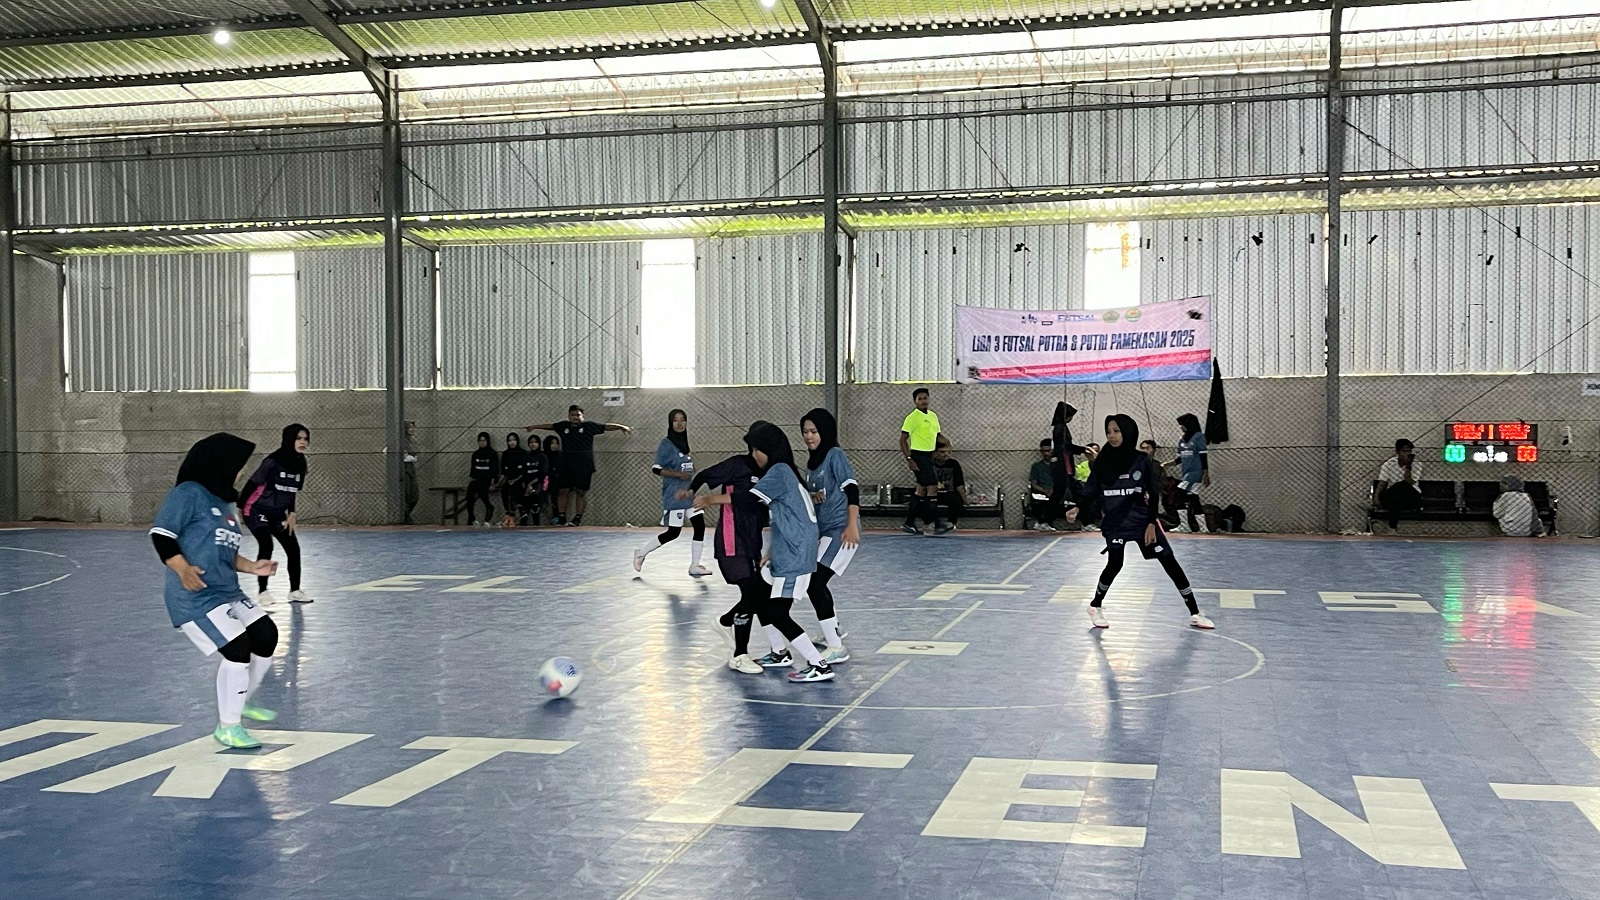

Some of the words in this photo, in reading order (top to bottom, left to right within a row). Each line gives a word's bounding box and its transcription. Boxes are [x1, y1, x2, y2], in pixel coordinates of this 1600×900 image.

[972, 335, 992, 353] LIGA
[994, 335, 1001, 353] 3
[1002, 335, 1036, 353] FUTSAL
[1038, 335, 1068, 353] PUTRA
[1080, 333, 1108, 351] PUTRI
[1110, 331, 1168, 350] PAMEKASAN
[1170, 329, 1196, 348] 2025
